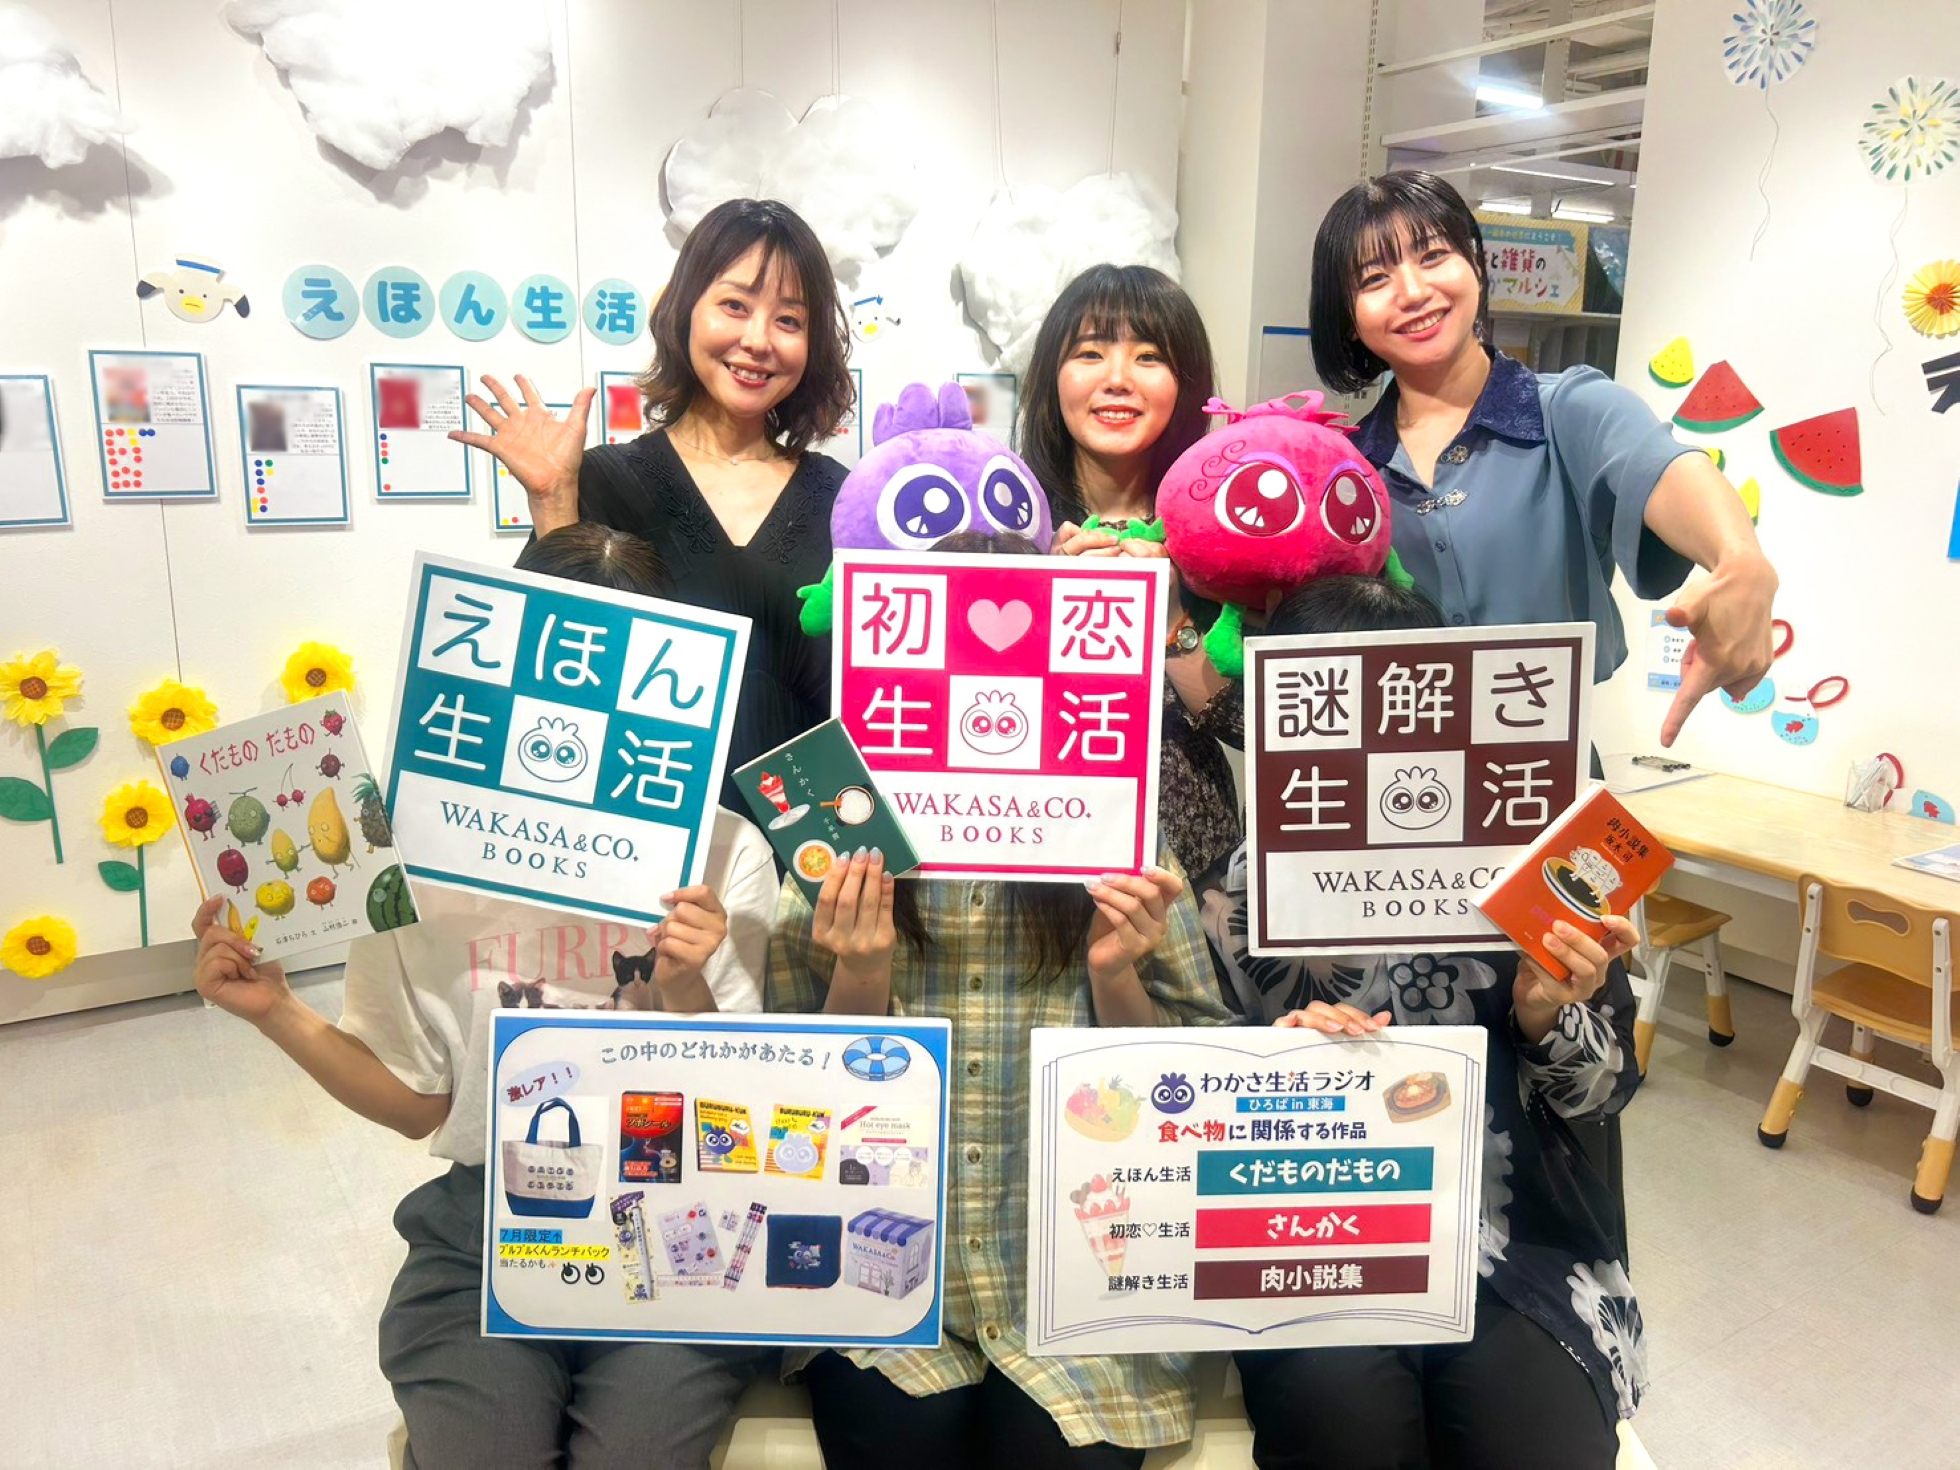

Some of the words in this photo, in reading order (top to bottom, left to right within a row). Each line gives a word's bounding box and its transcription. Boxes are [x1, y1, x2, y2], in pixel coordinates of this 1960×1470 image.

[1484, 247, 1546, 273] と雑貨の
[299, 277, 637, 334] えほん生活
[432, 593, 704, 710] えほん
[1276, 661, 1554, 739] 謎解き
[198, 739, 259, 776] くだもの
[266, 722, 316, 757] だもの
[940, 825, 1044, 844] BOOKS
[482, 842, 588, 879] BOOKS
[1362, 898, 1469, 918] BOOKS
[600, 1040, 832, 1071] この中のどれかがあたる！
[1199, 1069, 1376, 1094] わかさ生活ラジオ
[1248, 1097, 1288, 1111] ひろば
[1291, 1098, 1304, 1111] in
[1307, 1096, 1334, 1111] 東海
[890, 1121, 911, 1129] mask
[1158, 1119, 1368, 1143] 食べ物に関係する作品
[1111, 1166, 1192, 1184] えほん生活
[1228, 1158, 1401, 1187] くだものだもの
[1266, 1212, 1362, 1240] さんかく
[499, 1258, 547, 1269] 当たるかも
[1108, 1274, 1190, 1292] 謎解き生活
[1260, 1263, 1364, 1292] 肉小説集
